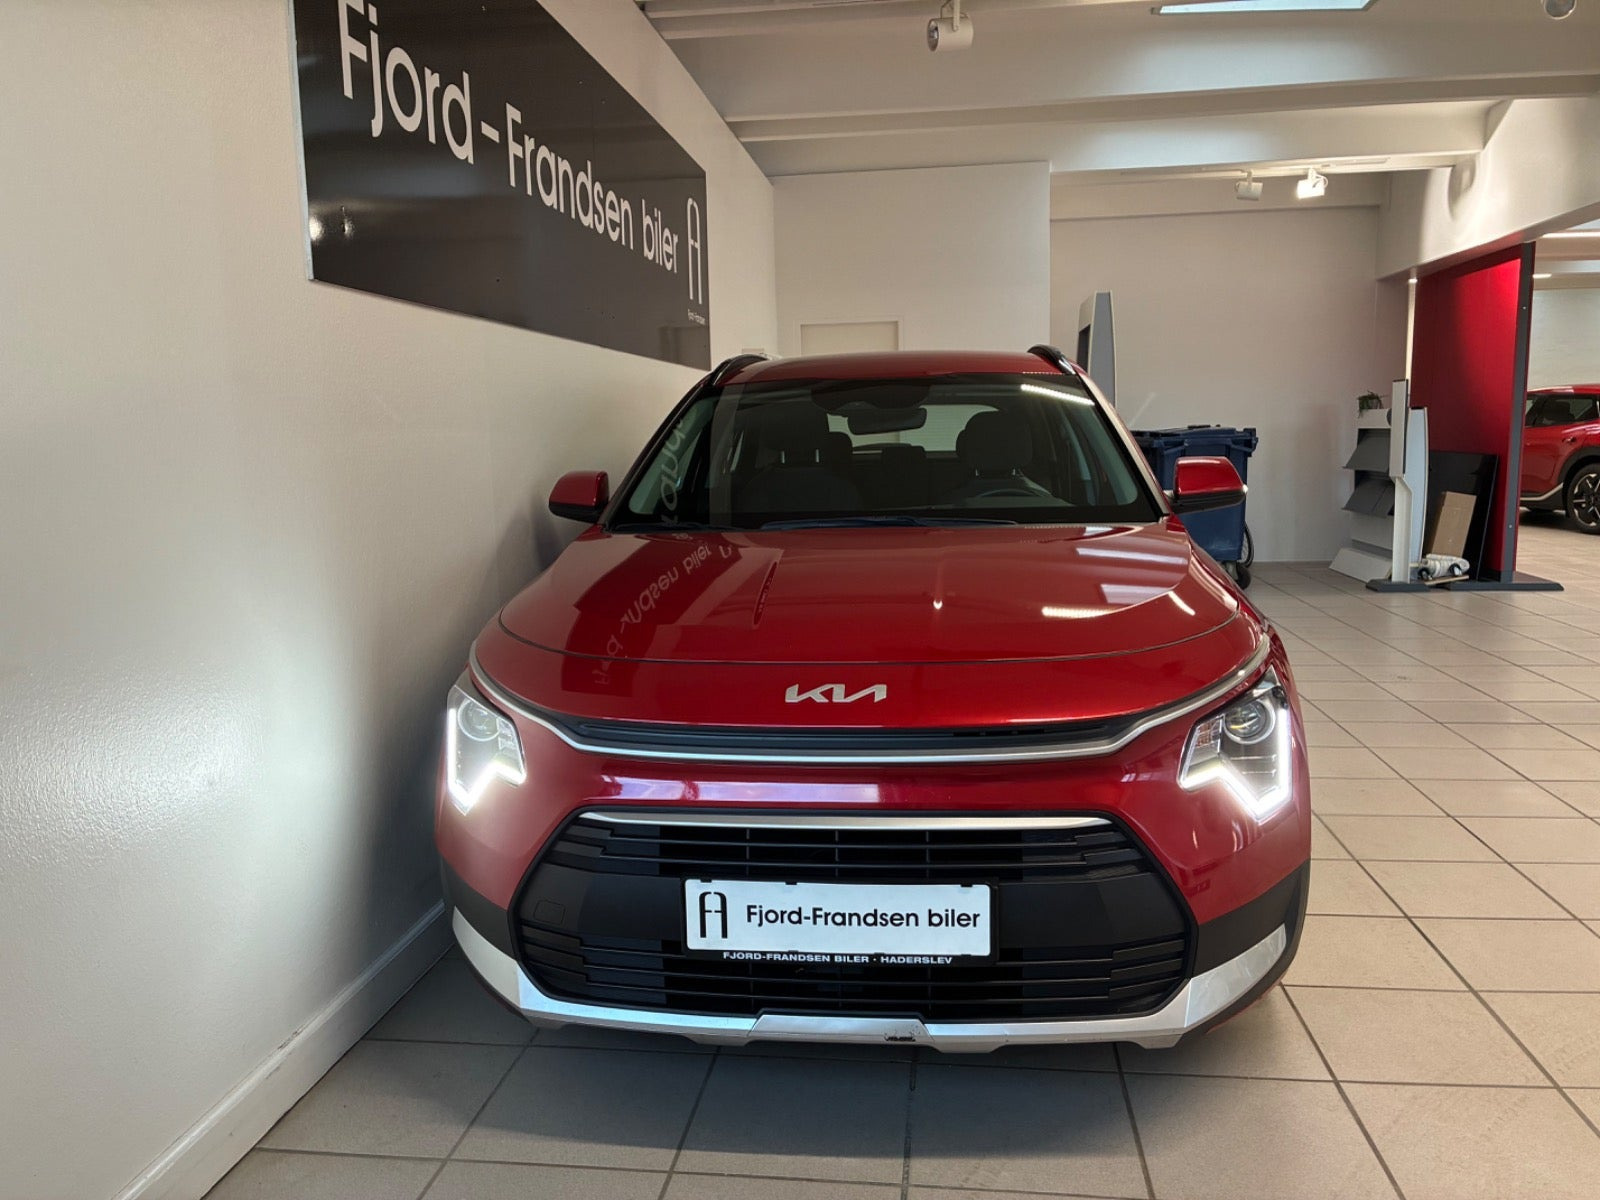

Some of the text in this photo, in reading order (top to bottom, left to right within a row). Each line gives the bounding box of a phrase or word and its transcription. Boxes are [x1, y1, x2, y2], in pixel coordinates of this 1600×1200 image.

[642, 198, 679, 273] biler
[785, 683, 888, 703] KIA
[746, 904, 981, 928] Fjord-Frandsen biler
[722, 951, 953, 965] FJORD-FRANDSEN BILER HADERSLEV
